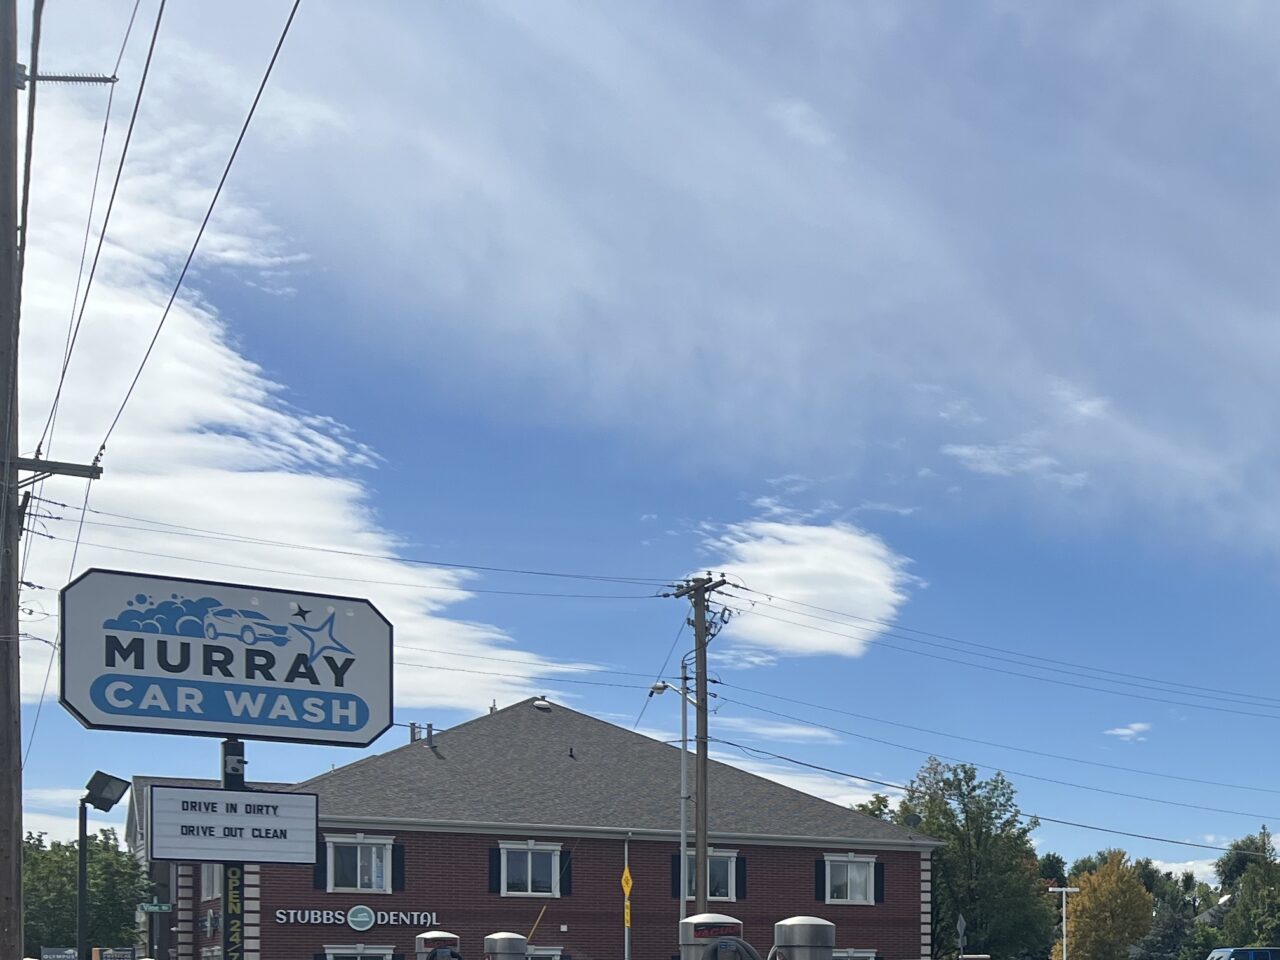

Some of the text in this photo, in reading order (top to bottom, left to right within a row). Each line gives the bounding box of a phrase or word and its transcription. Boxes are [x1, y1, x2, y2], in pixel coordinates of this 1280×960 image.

[105, 635, 356, 688] MURRAY
[104, 681, 357, 725] CAR WASH
[181, 800, 279, 816] DRIVE IN DIRTY
[180, 825, 288, 839] DRIVE OUT CLEAN
[227, 867, 241, 914] OPEN
[275, 909, 441, 927] STUBBS DENTAL
[694, 926, 741, 938] VACUU
